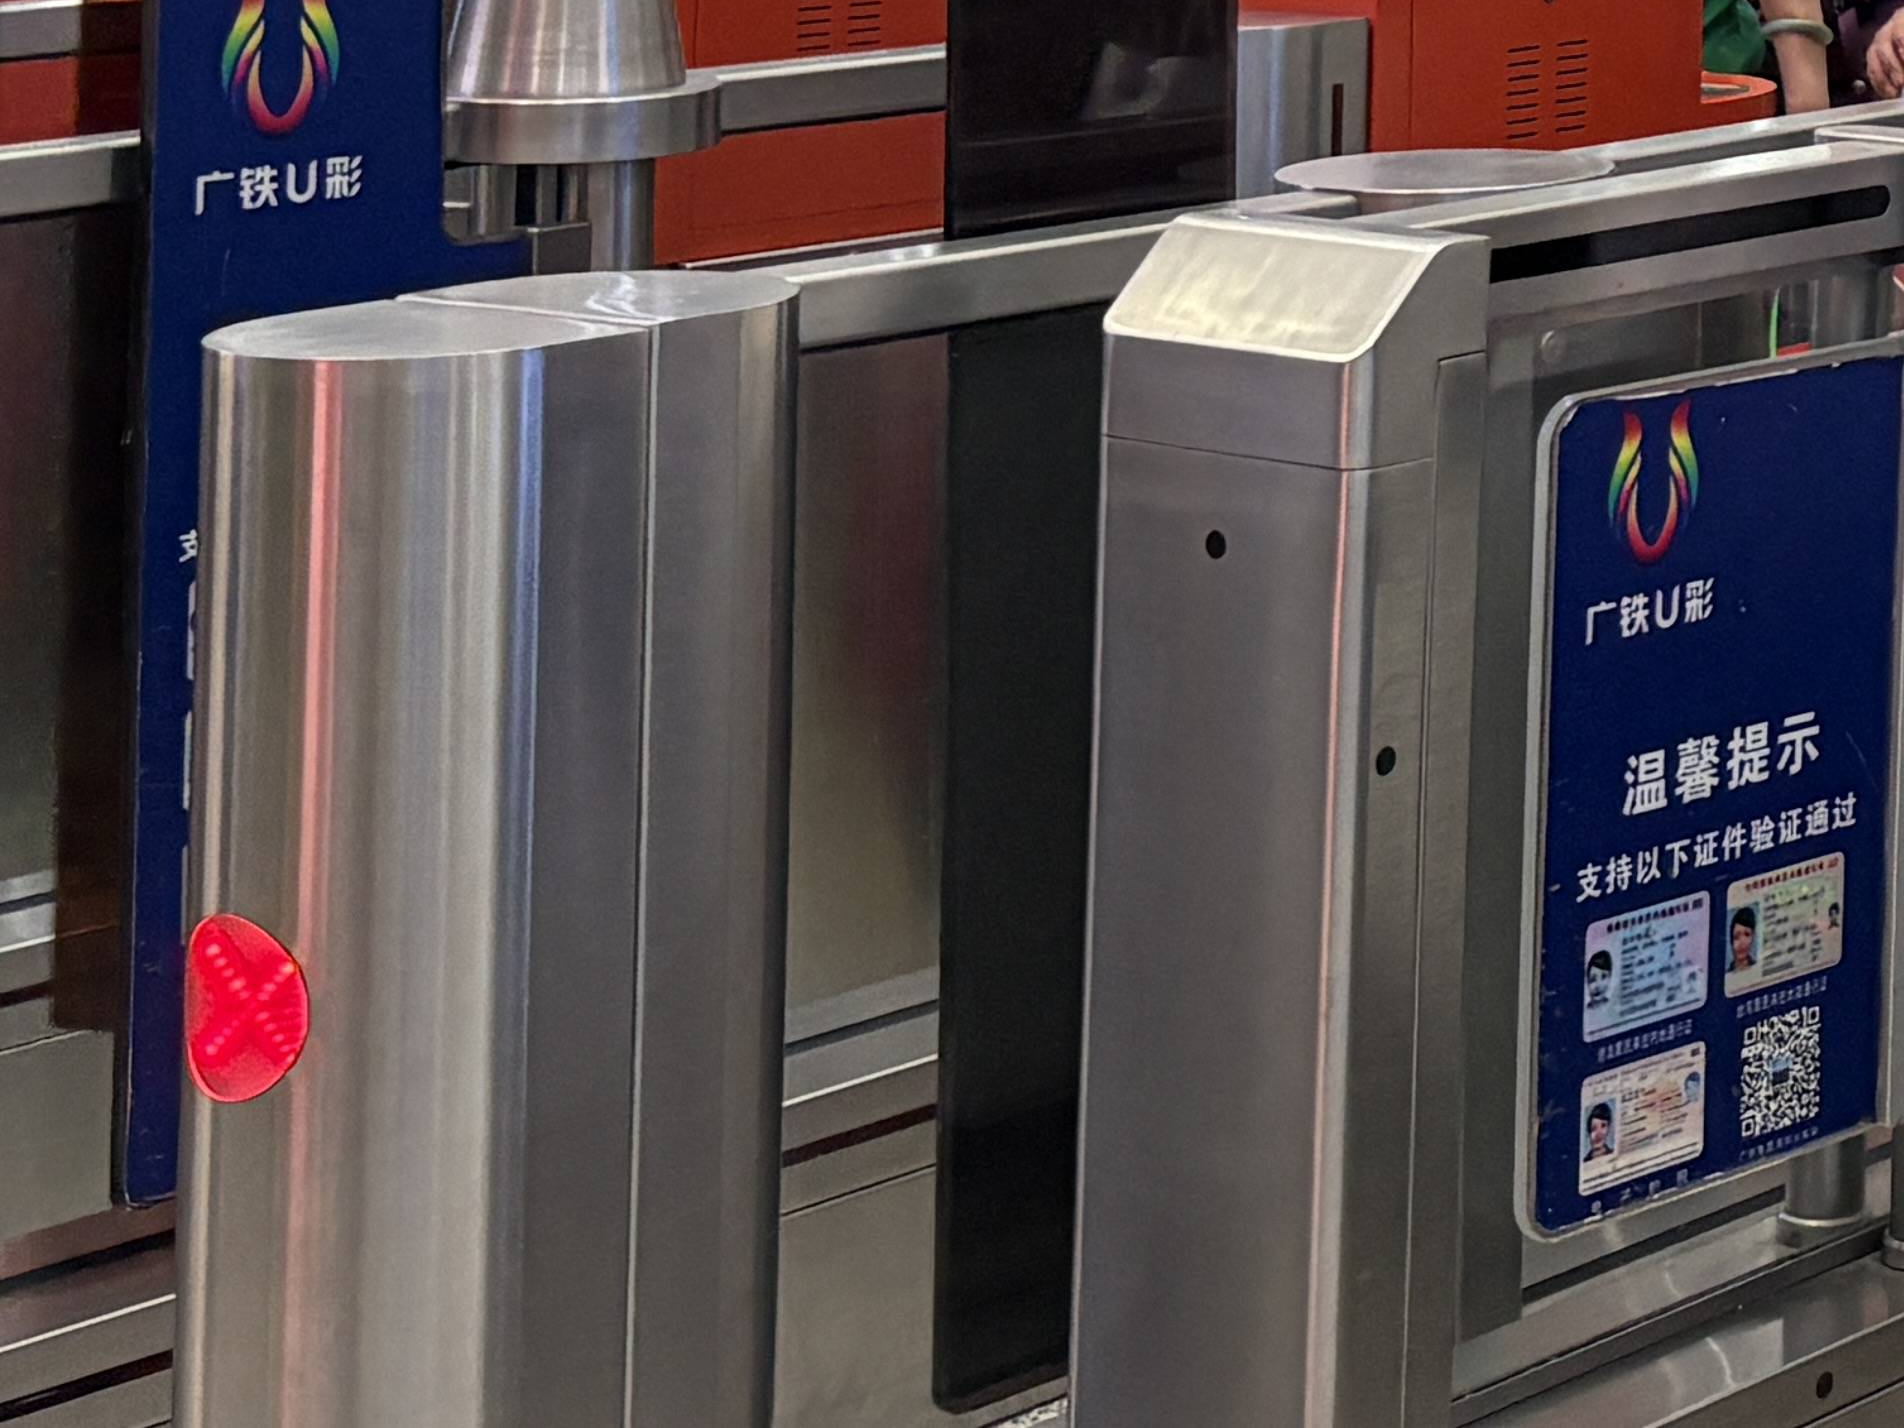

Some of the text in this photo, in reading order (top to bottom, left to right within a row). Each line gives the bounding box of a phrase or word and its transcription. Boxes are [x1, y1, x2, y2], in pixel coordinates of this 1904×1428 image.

[195, 155, 363, 216] 广铁U彩
[1585, 577, 1715, 645] 广铁U彩
[1622, 711, 1821, 816] 温馨提示
[1576, 792, 1857, 903] 支持以下证件验证通过
